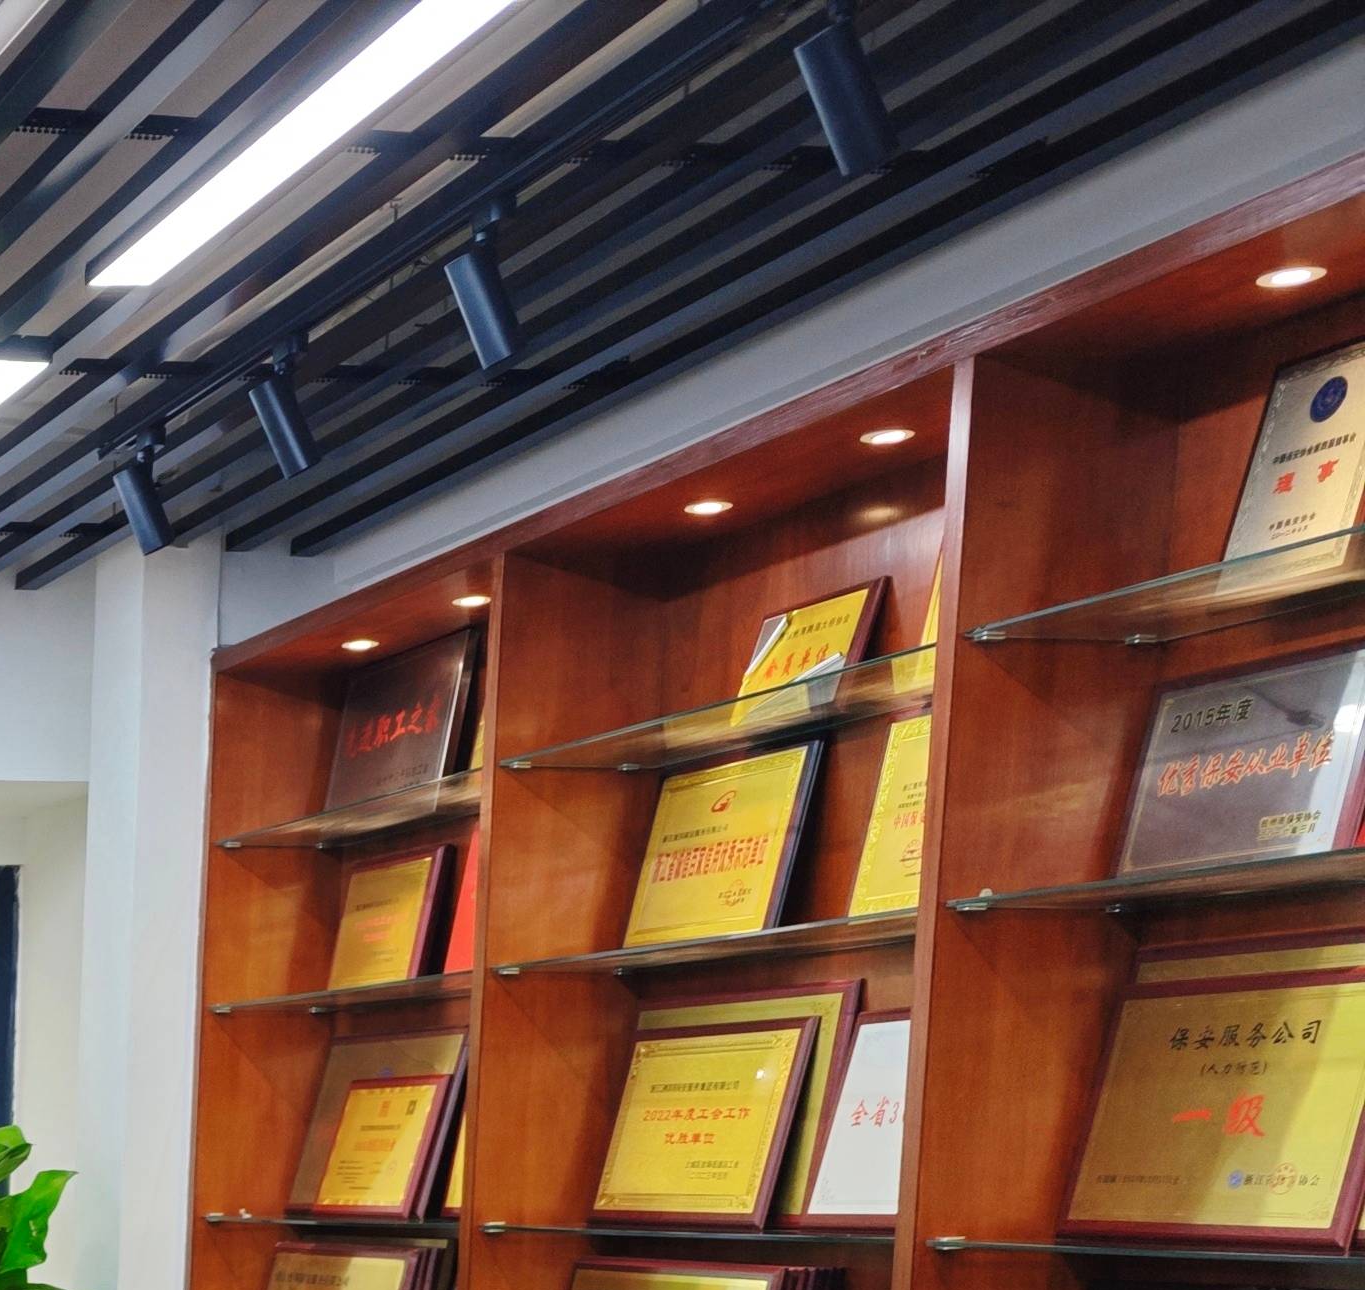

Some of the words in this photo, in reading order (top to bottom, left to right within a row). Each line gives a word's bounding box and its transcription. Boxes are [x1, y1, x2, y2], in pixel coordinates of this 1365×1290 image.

[1170, 698, 1254, 733] 2015年度
[1169, 1019, 1322, 1051] 保安服务公司
[643, 1107, 751, 1122] 2022年度工会工作
[1171, 1088, 1266, 1137] 一级
